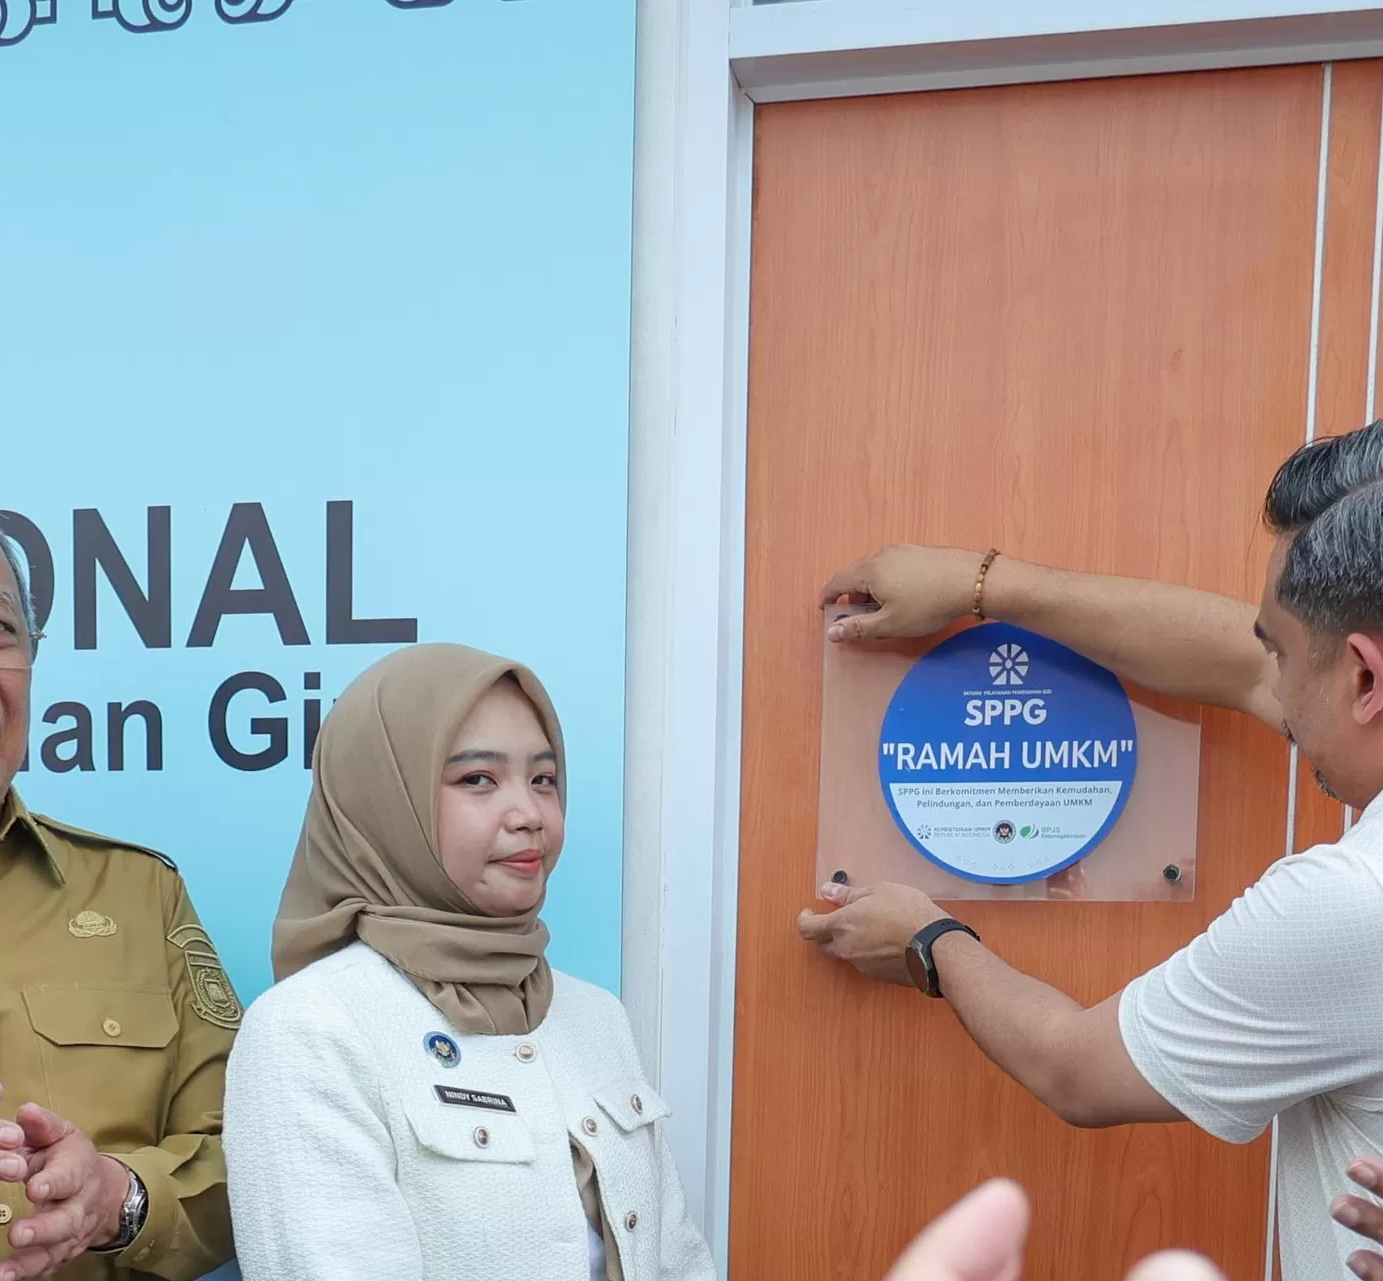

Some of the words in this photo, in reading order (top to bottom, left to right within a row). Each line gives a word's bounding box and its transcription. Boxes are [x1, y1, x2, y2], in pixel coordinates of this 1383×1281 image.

[964, 698, 1047, 726] SPPG
[882, 741, 1010, 771] "RAMAH
[1021, 740, 1133, 769] UMKM"
[897, 787, 920, 796] SPPG
[935, 787, 995, 795] Berkomitmen
[998, 786, 1054, 795] Memberikan
[1056, 785, 1112, 795] Kemudahan,
[917, 799, 973, 809] Pelindungan,
[976, 799, 992, 807] dan
[995, 799, 1061, 809] Pemberdayaan
[1063, 799, 1093, 807] UMKM
